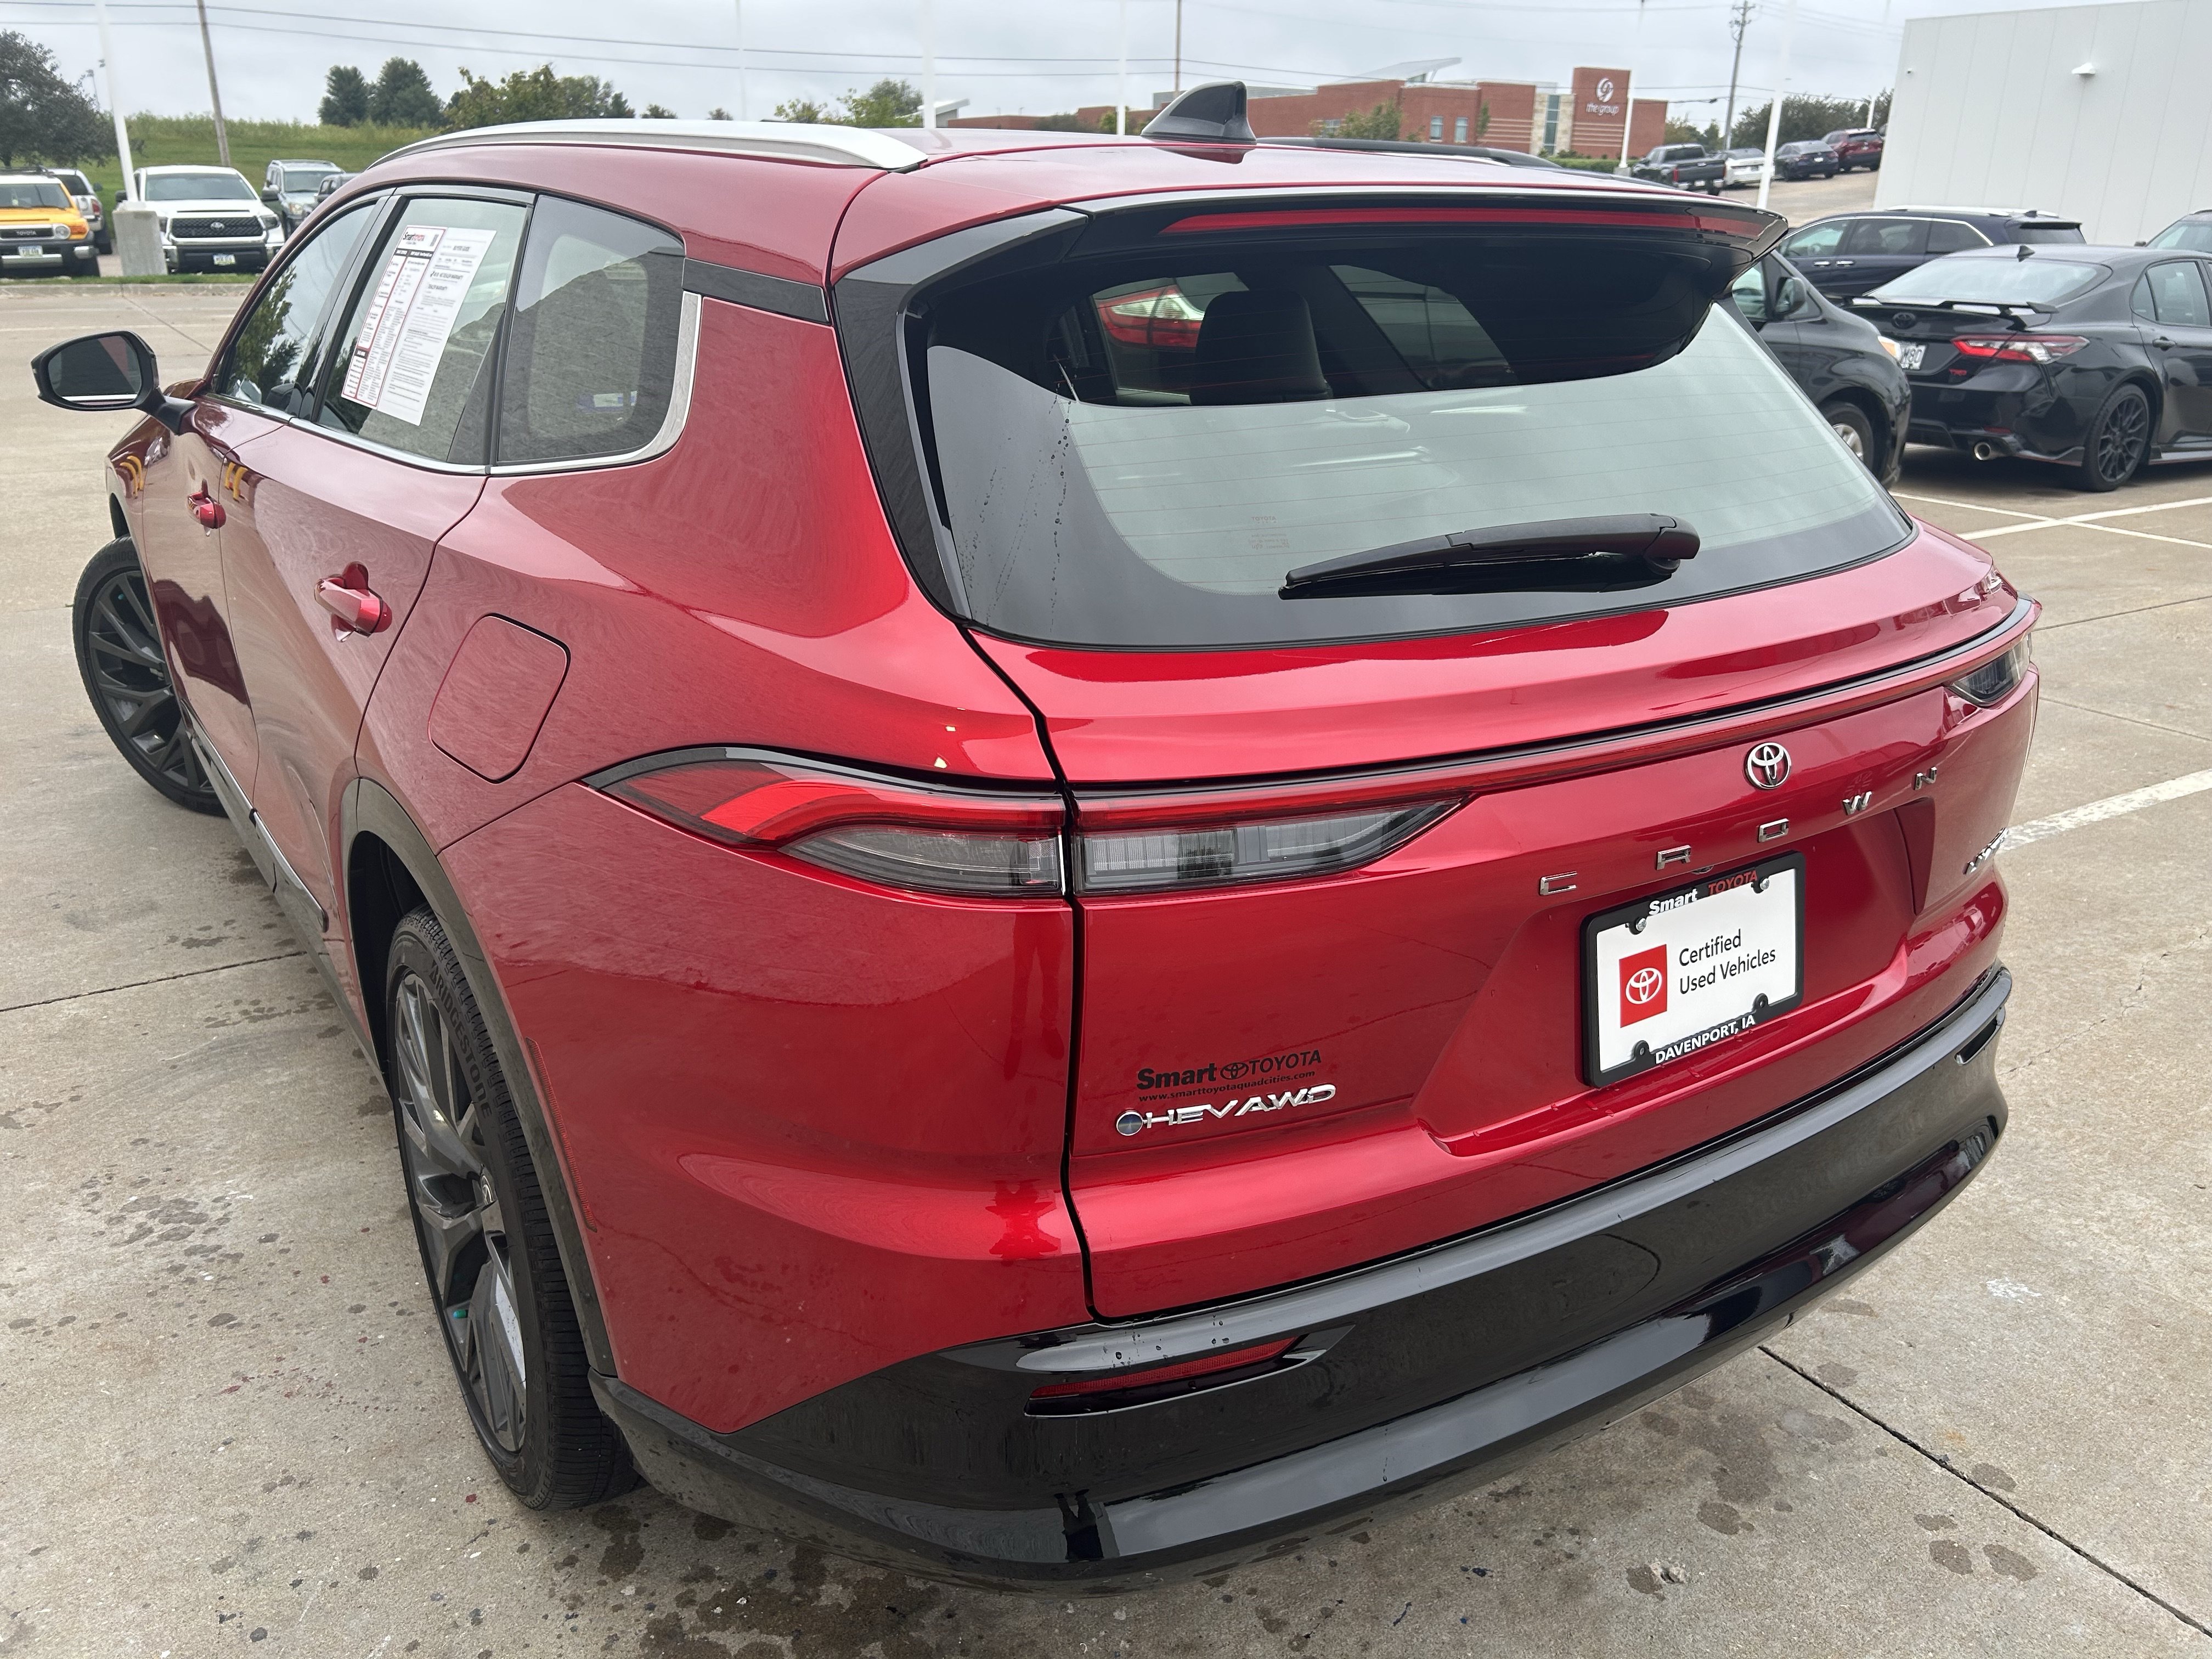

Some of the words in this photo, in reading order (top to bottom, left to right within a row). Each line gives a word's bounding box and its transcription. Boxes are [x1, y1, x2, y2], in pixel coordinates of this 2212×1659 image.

[1598, 105, 1619, 116] group
[1649, 888, 1698, 916] Smart
[1708, 870, 1758, 896] TOYOTA
[1679, 928, 1741, 966] Certified
[1680, 965, 1716, 994] Used
[1720, 949, 1776, 980] Vehicles
[428, 960, 493, 1118] BRIDGESTONE
[1655, 1021, 1739, 1064] DAVENPORT,
[1741, 1014, 1756, 1029] IA
[1136, 1063, 1217, 1090] Smart
[1249, 1049, 1322, 1075] TOYOTA
[1139, 1069, 1316, 1102] www.smarttoyotaquadcities.com
